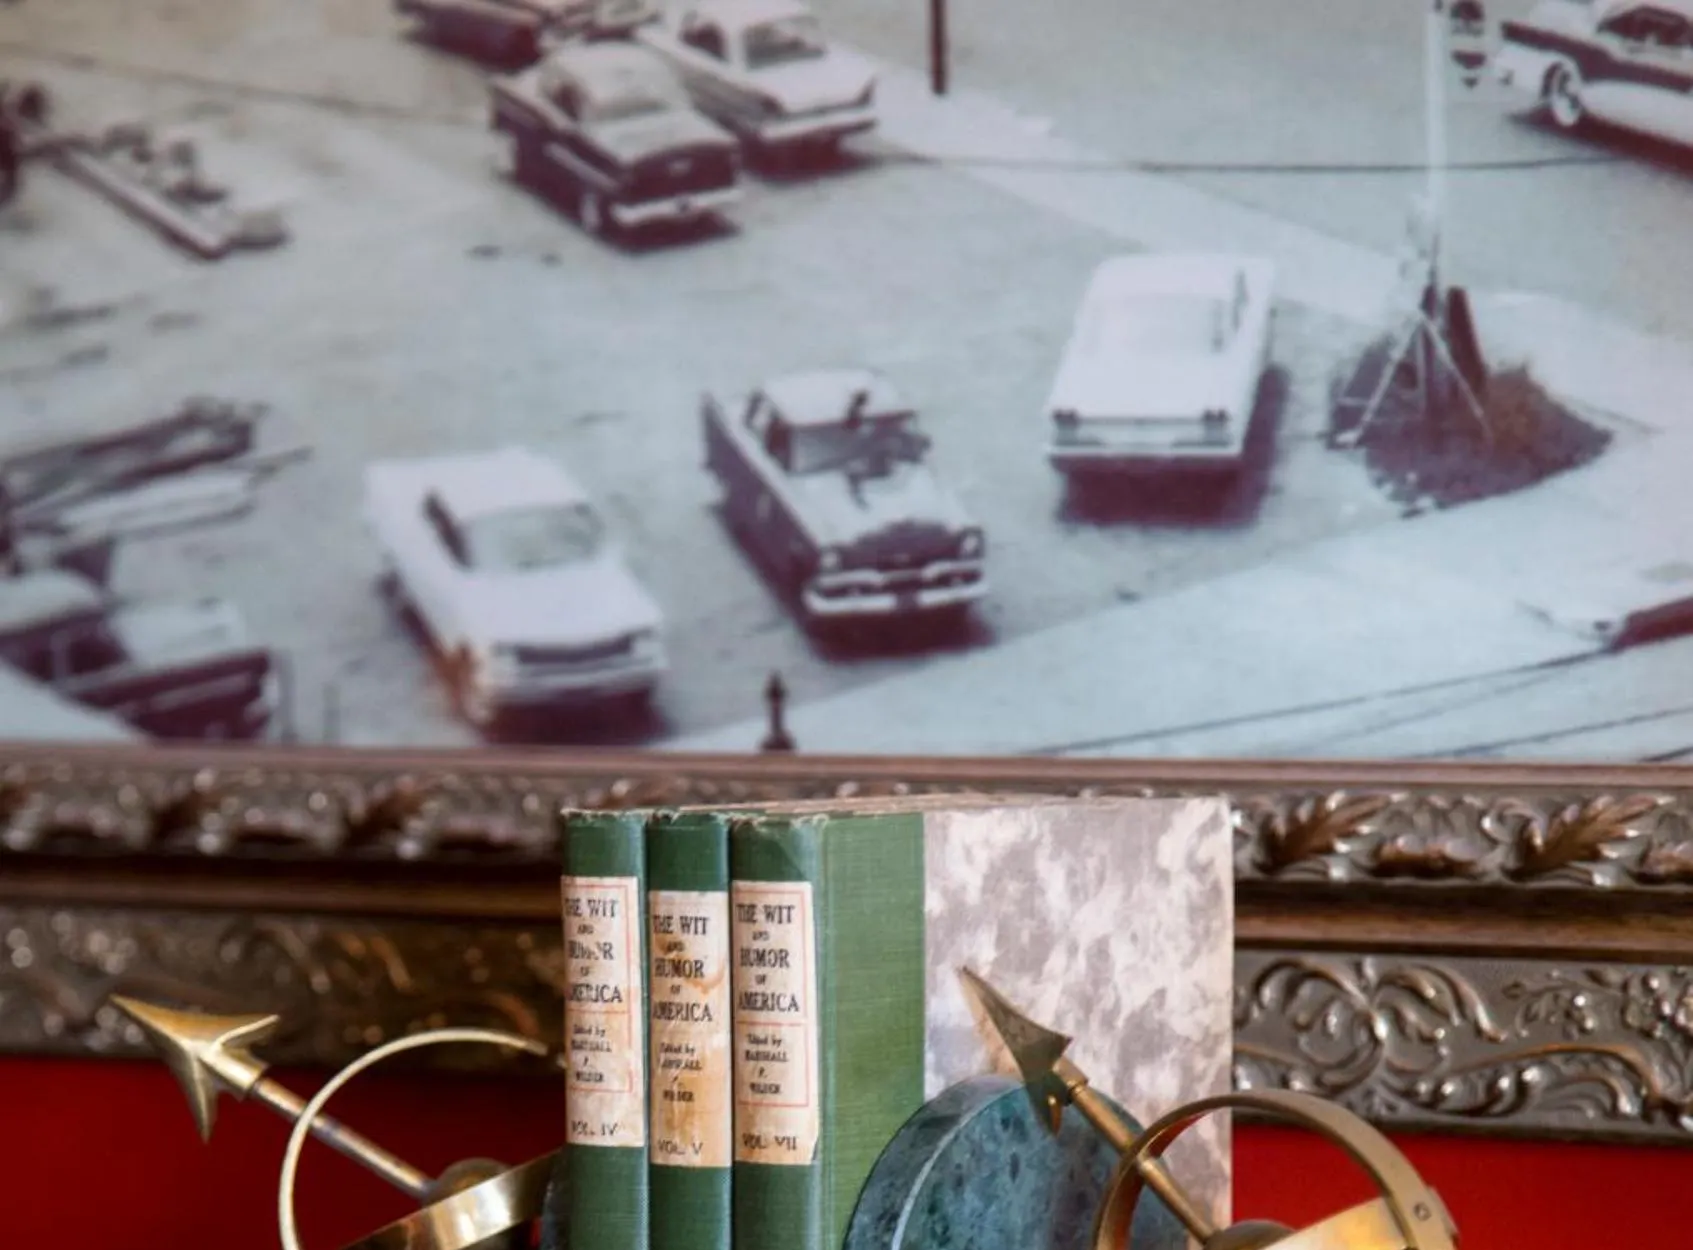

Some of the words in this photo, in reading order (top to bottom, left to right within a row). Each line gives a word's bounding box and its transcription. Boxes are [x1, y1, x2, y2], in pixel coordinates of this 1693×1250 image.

[587, 899, 618, 917] WIT
[736, 903, 758, 923] THE
[762, 903, 795, 924] WIT
[653, 915, 674, 934] THE
[680, 915, 709, 935] WIT
[739, 947, 790, 968] HUMOR
[655, 958, 705, 978] HUMOR
[755, 974, 767, 985] OF
[652, 1001, 713, 1022] AMERICA
[737, 991, 800, 1012] AMERICA
[601, 1123, 618, 1136] IV
[692, 1142, 704, 1155] V
[774, 1135, 797, 1151] VII
